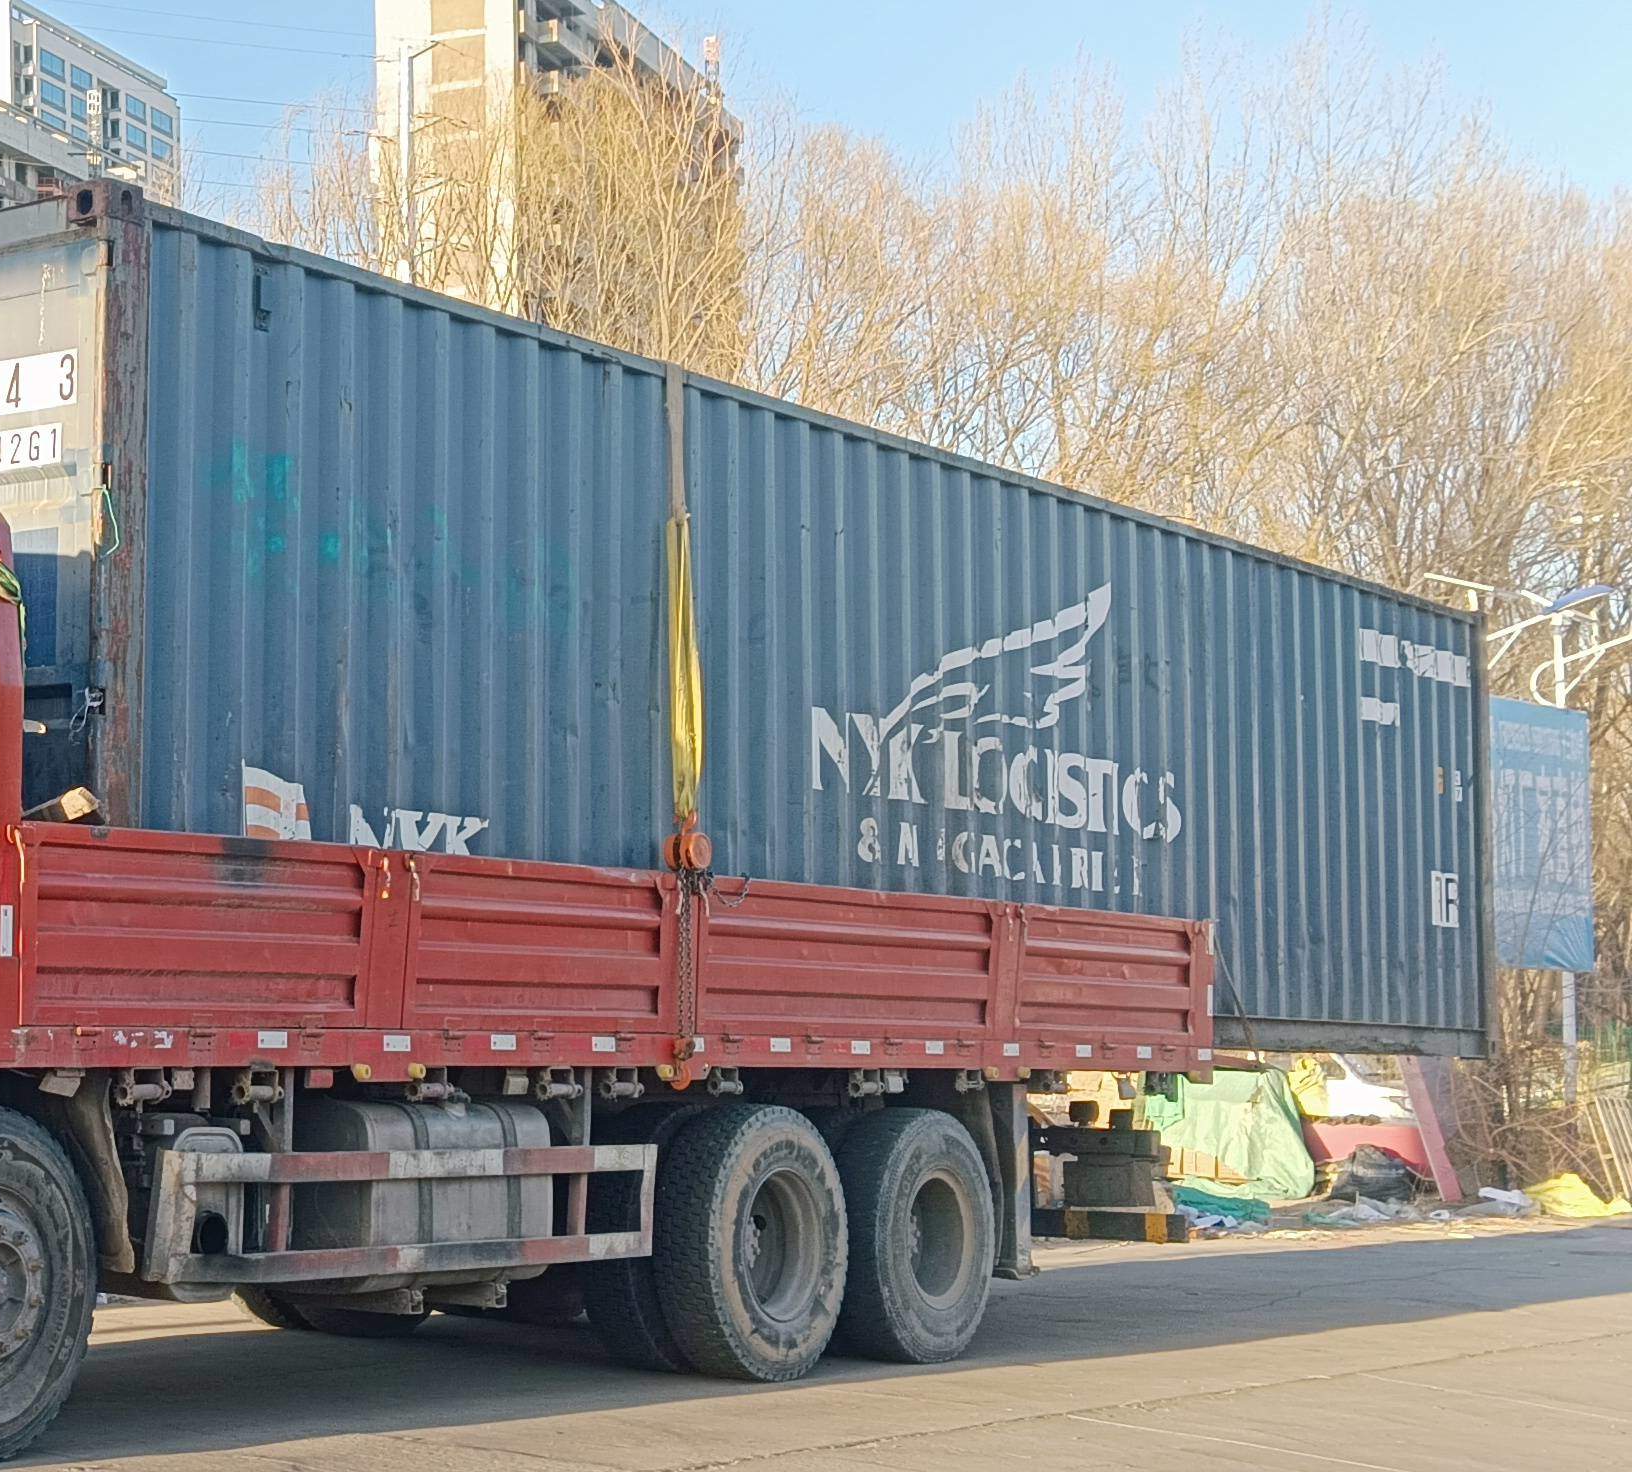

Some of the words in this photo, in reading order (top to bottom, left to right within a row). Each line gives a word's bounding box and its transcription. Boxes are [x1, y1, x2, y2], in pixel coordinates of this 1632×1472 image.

[58, 353, 75, 401] 3
[811, 705, 928, 804] NYK
[349, 803, 490, 856] NYK
[857, 817, 881, 864] &
